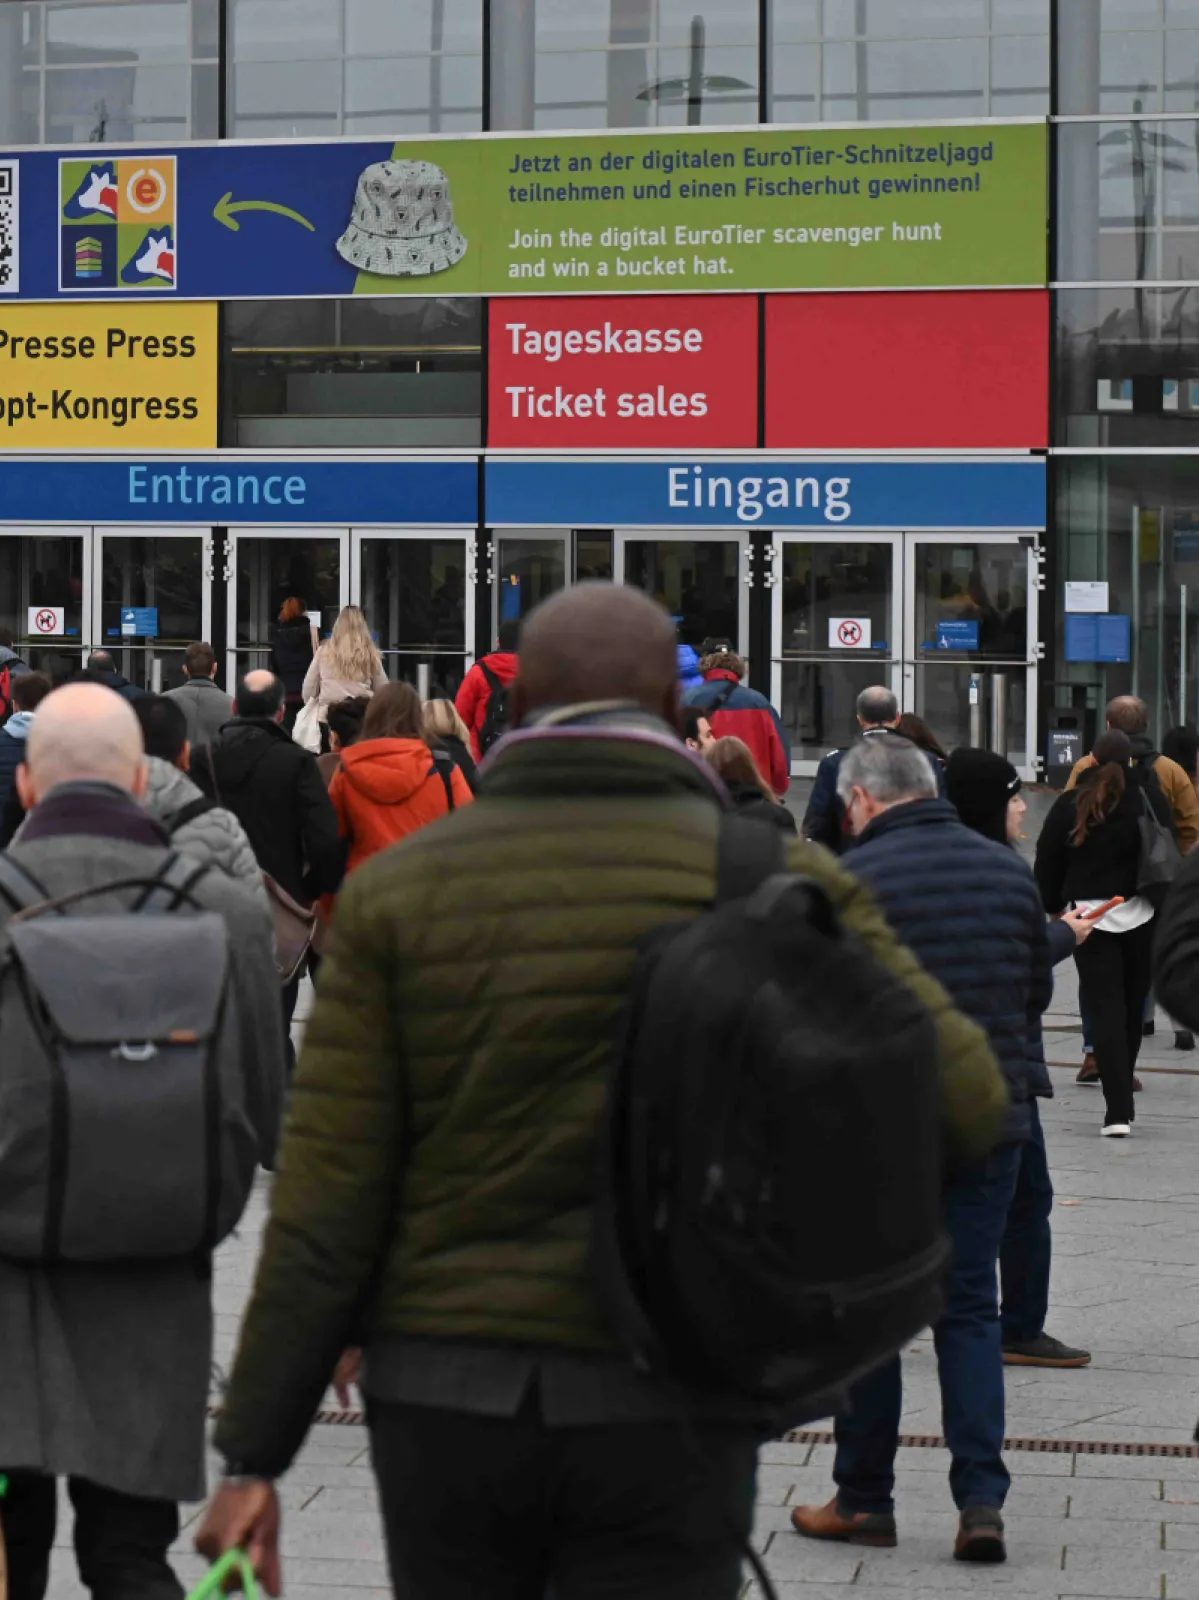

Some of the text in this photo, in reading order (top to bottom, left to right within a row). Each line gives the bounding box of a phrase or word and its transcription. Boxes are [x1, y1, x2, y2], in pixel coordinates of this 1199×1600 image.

[509, 141, 993, 174] Jetzt an der digitalen EuroTier-Schnitzeljagd
[509, 173, 981, 202] teilnehmen und einen Fischerhut gewinnen!
[509, 222, 941, 250] Join the digital EuroTier scavenger hunt
[509, 254, 733, 277] and win a bucket hat.
[107, 329, 195, 357] Press
[506, 322, 702, 361] Tageskasse
[506, 385, 707, 417] Ticket sales
[130, 466, 305, 504] Entrance
[668, 467, 851, 521] Eingang
